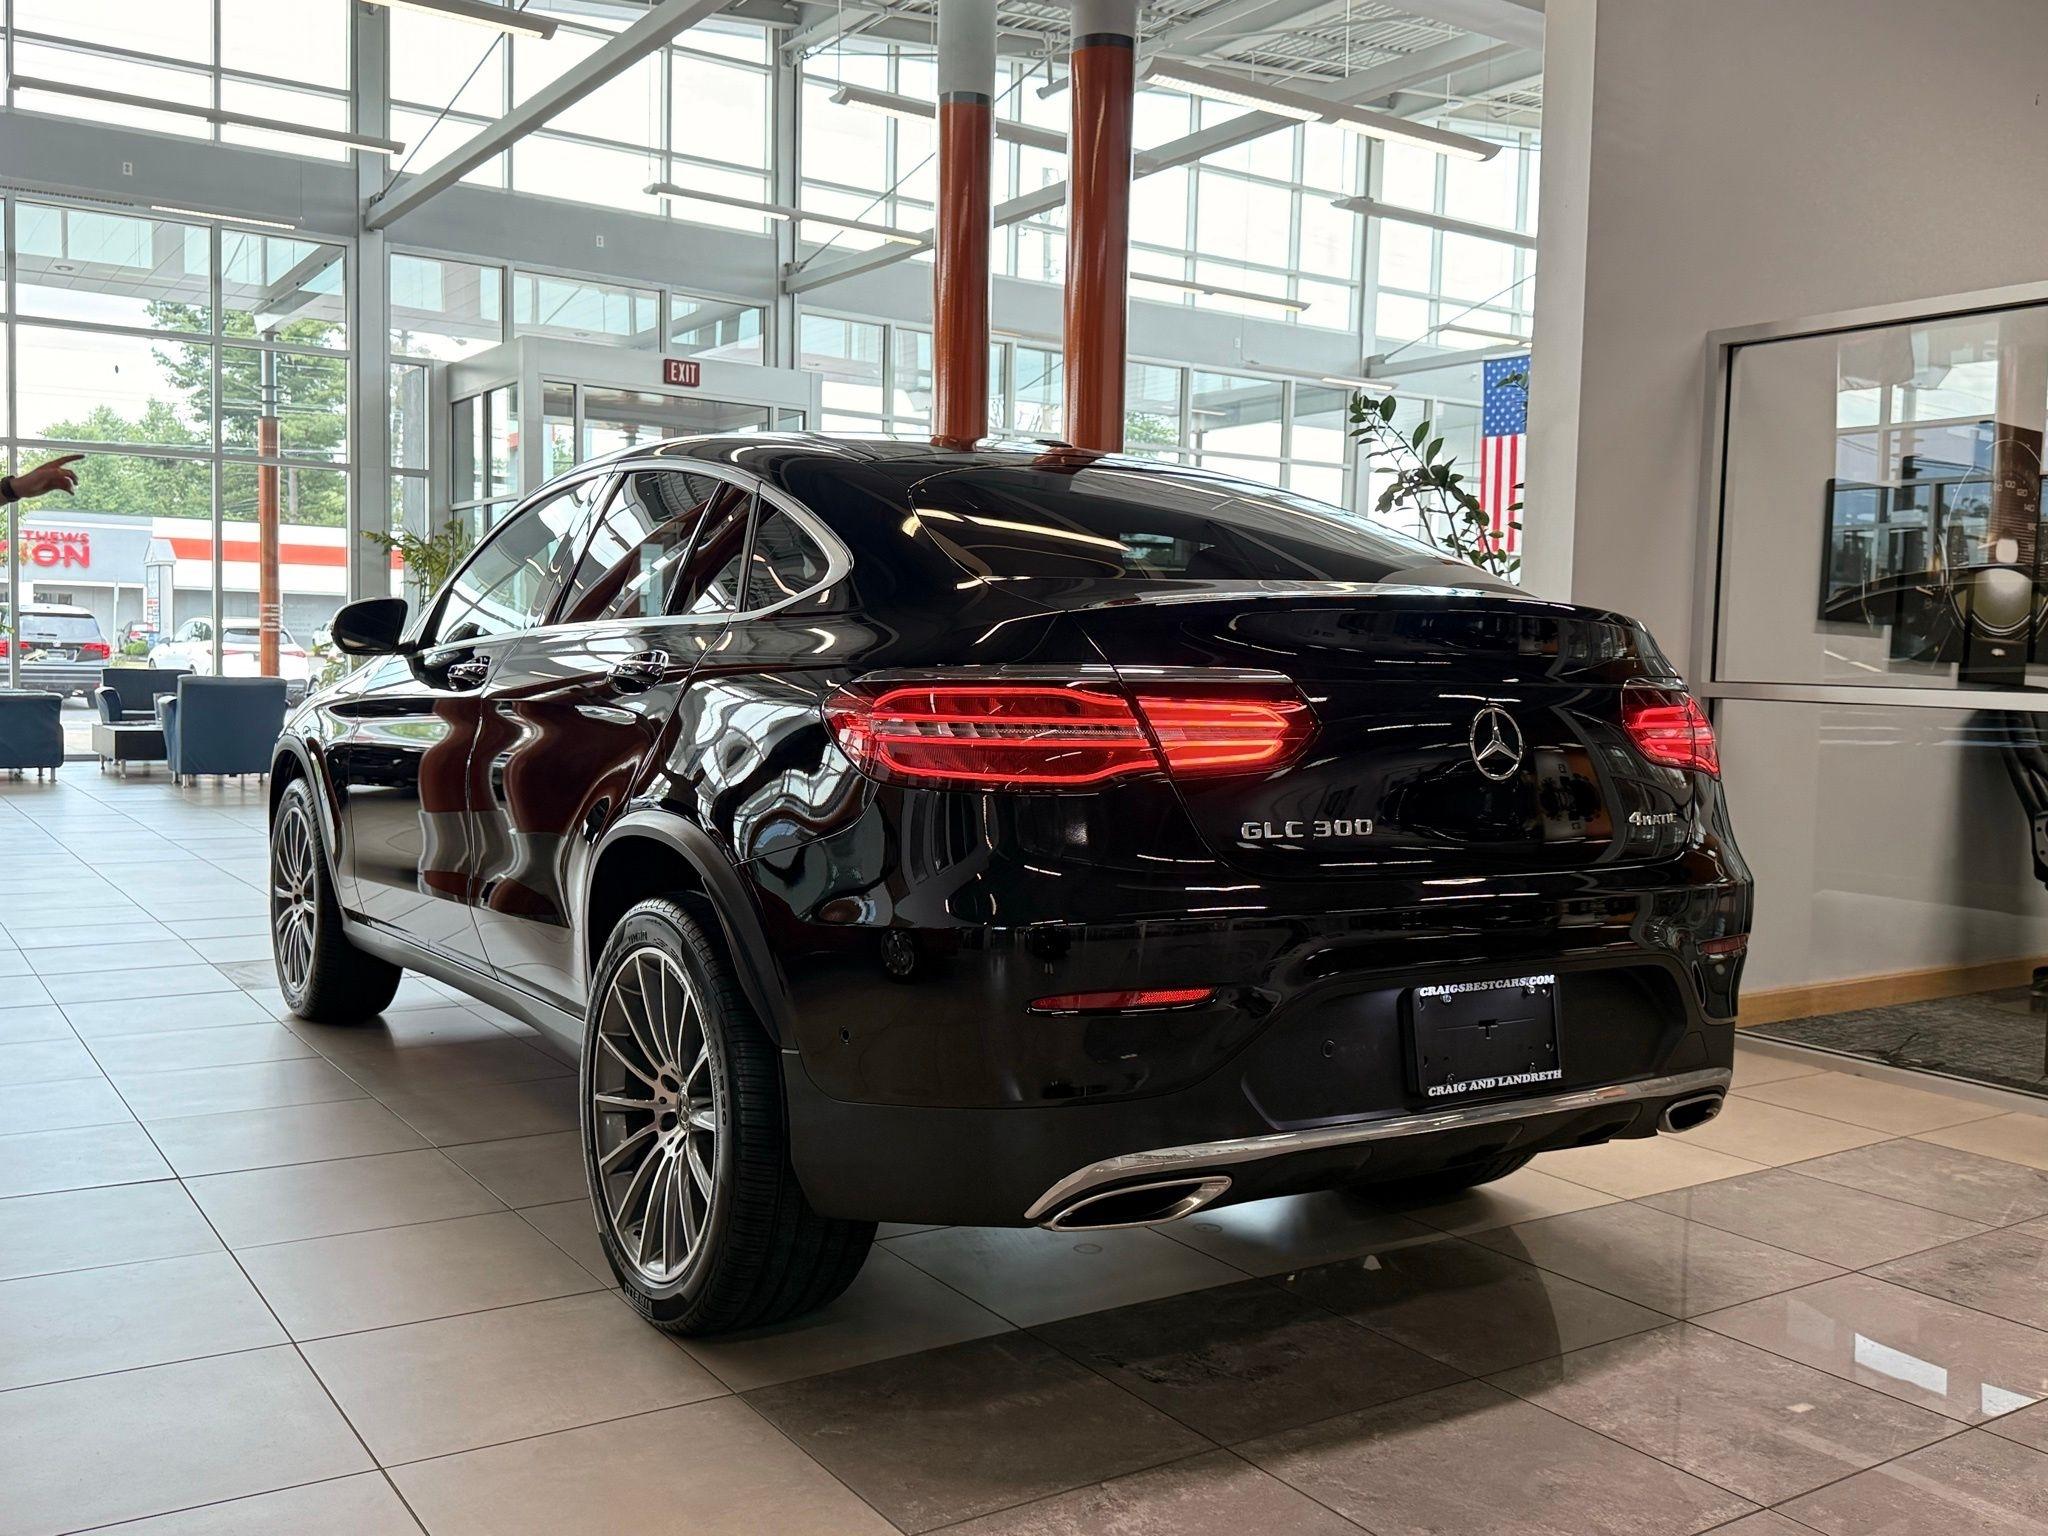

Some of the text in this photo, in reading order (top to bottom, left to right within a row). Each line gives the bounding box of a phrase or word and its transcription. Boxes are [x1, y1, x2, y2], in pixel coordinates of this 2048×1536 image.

[671, 362, 696, 384] EXIT
[21, 530, 90, 545] THEWS
[1241, 818, 1373, 840] GLC 300
[1628, 811, 1678, 826] 4MATIC
[1419, 974, 1556, 997] CRAIGSBESTCARS.COM
[1428, 1069, 1563, 1097] CRAIG AND LANDRETH
